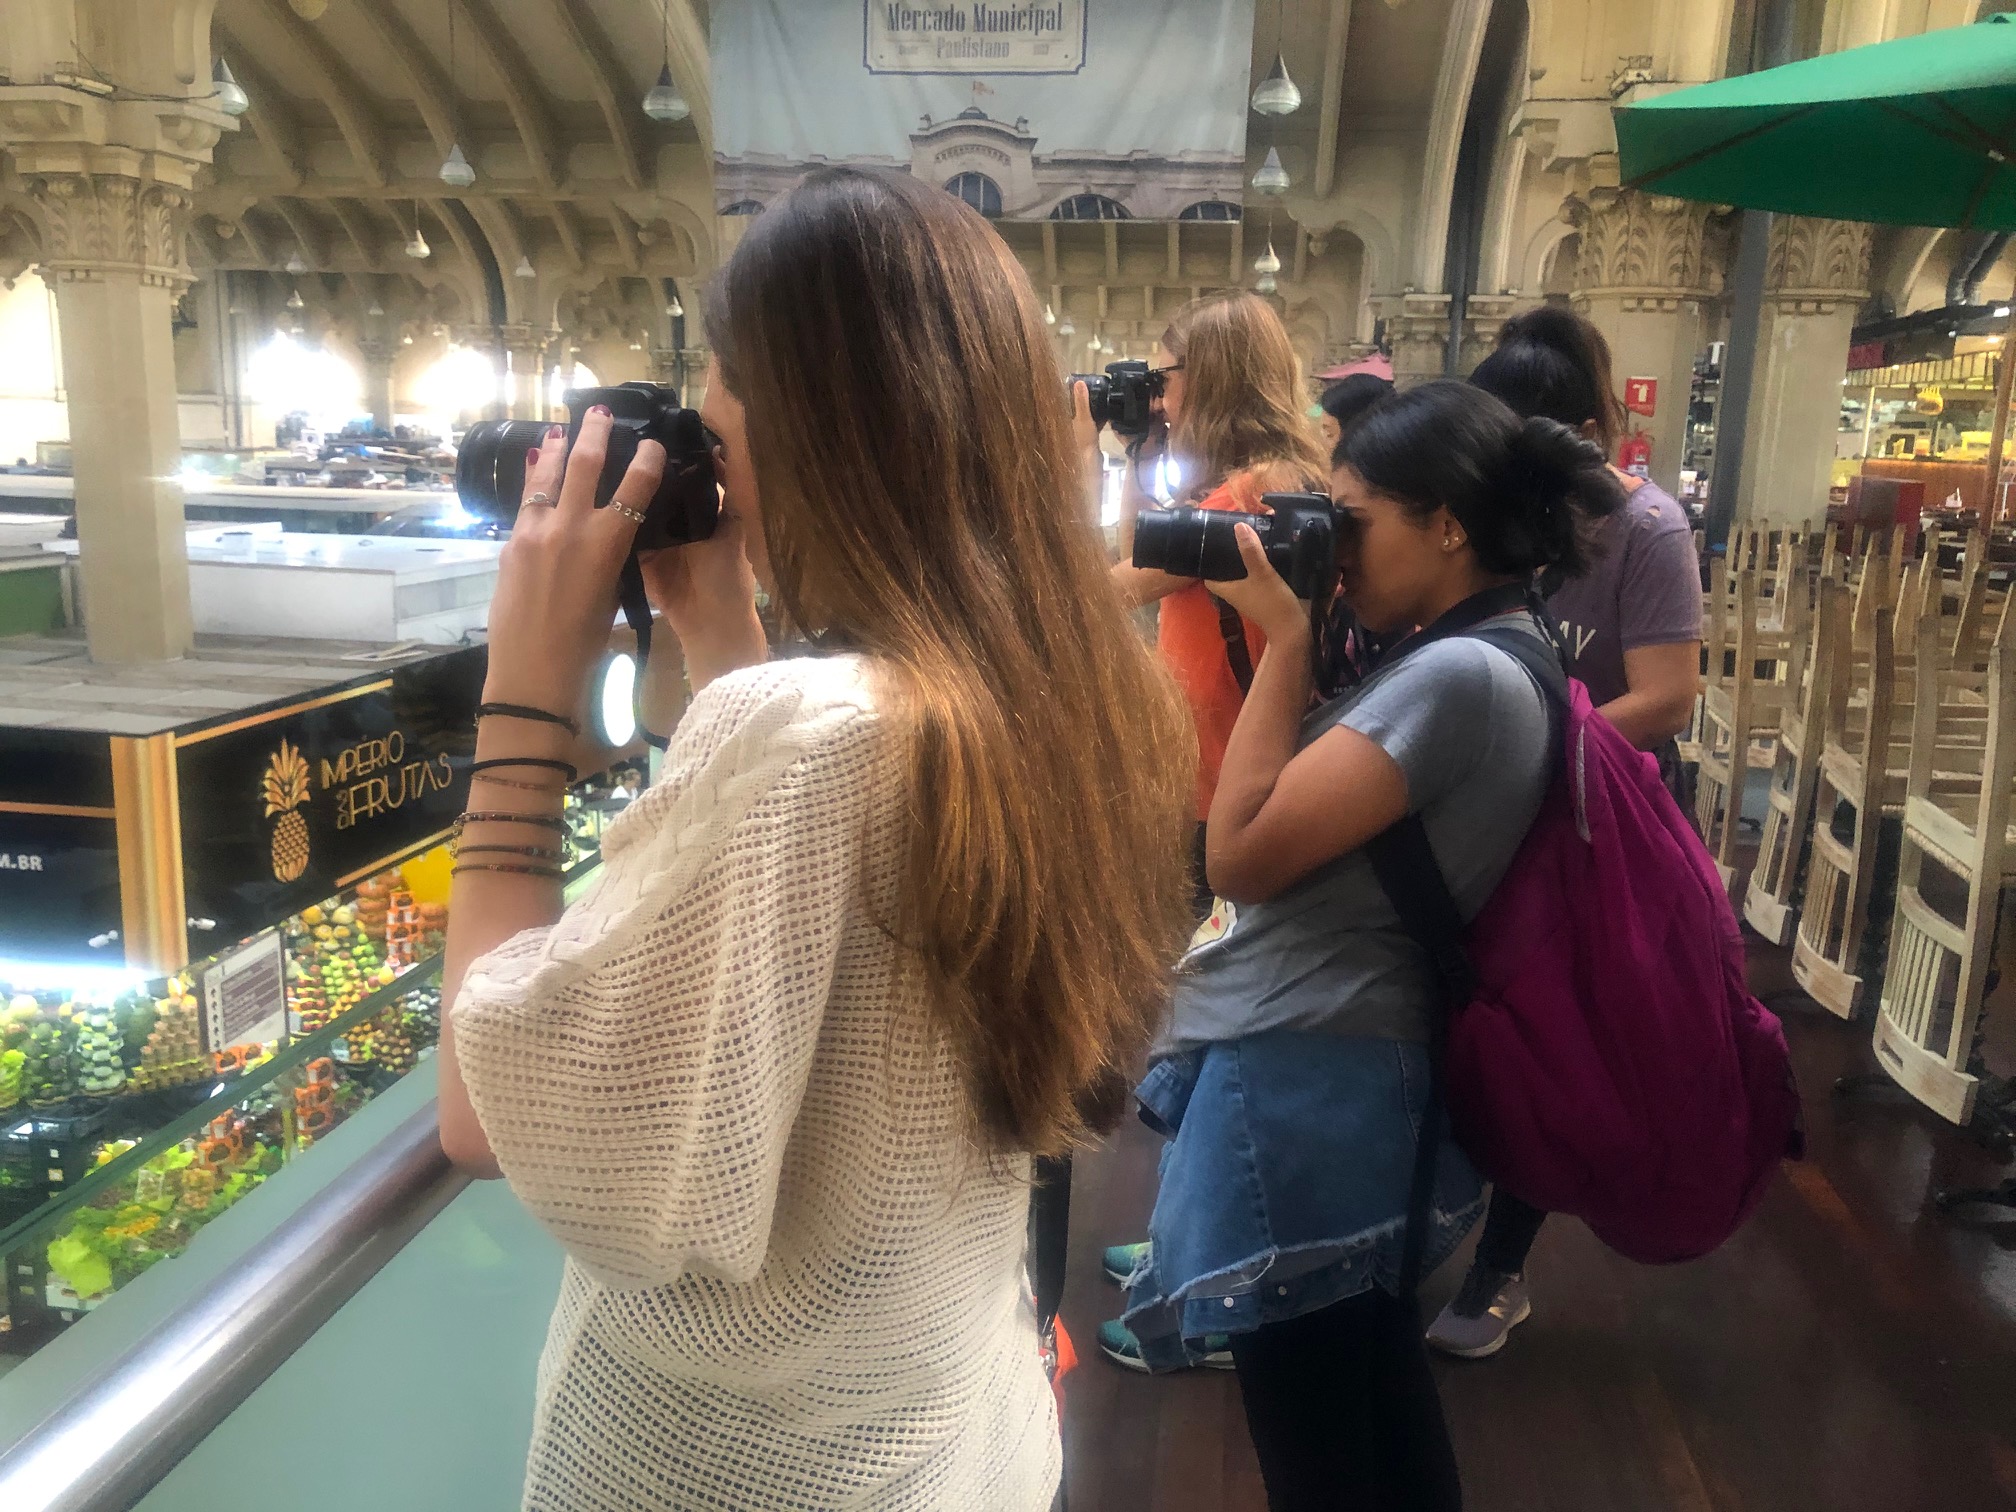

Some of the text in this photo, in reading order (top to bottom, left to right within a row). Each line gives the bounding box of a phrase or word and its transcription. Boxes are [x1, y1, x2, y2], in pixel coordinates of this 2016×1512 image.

[888, 2, 1063, 35] Mercado Municipal
[937, 37, 1010, 58] Paulistano
[350, 752, 452, 826] FRUTAS
